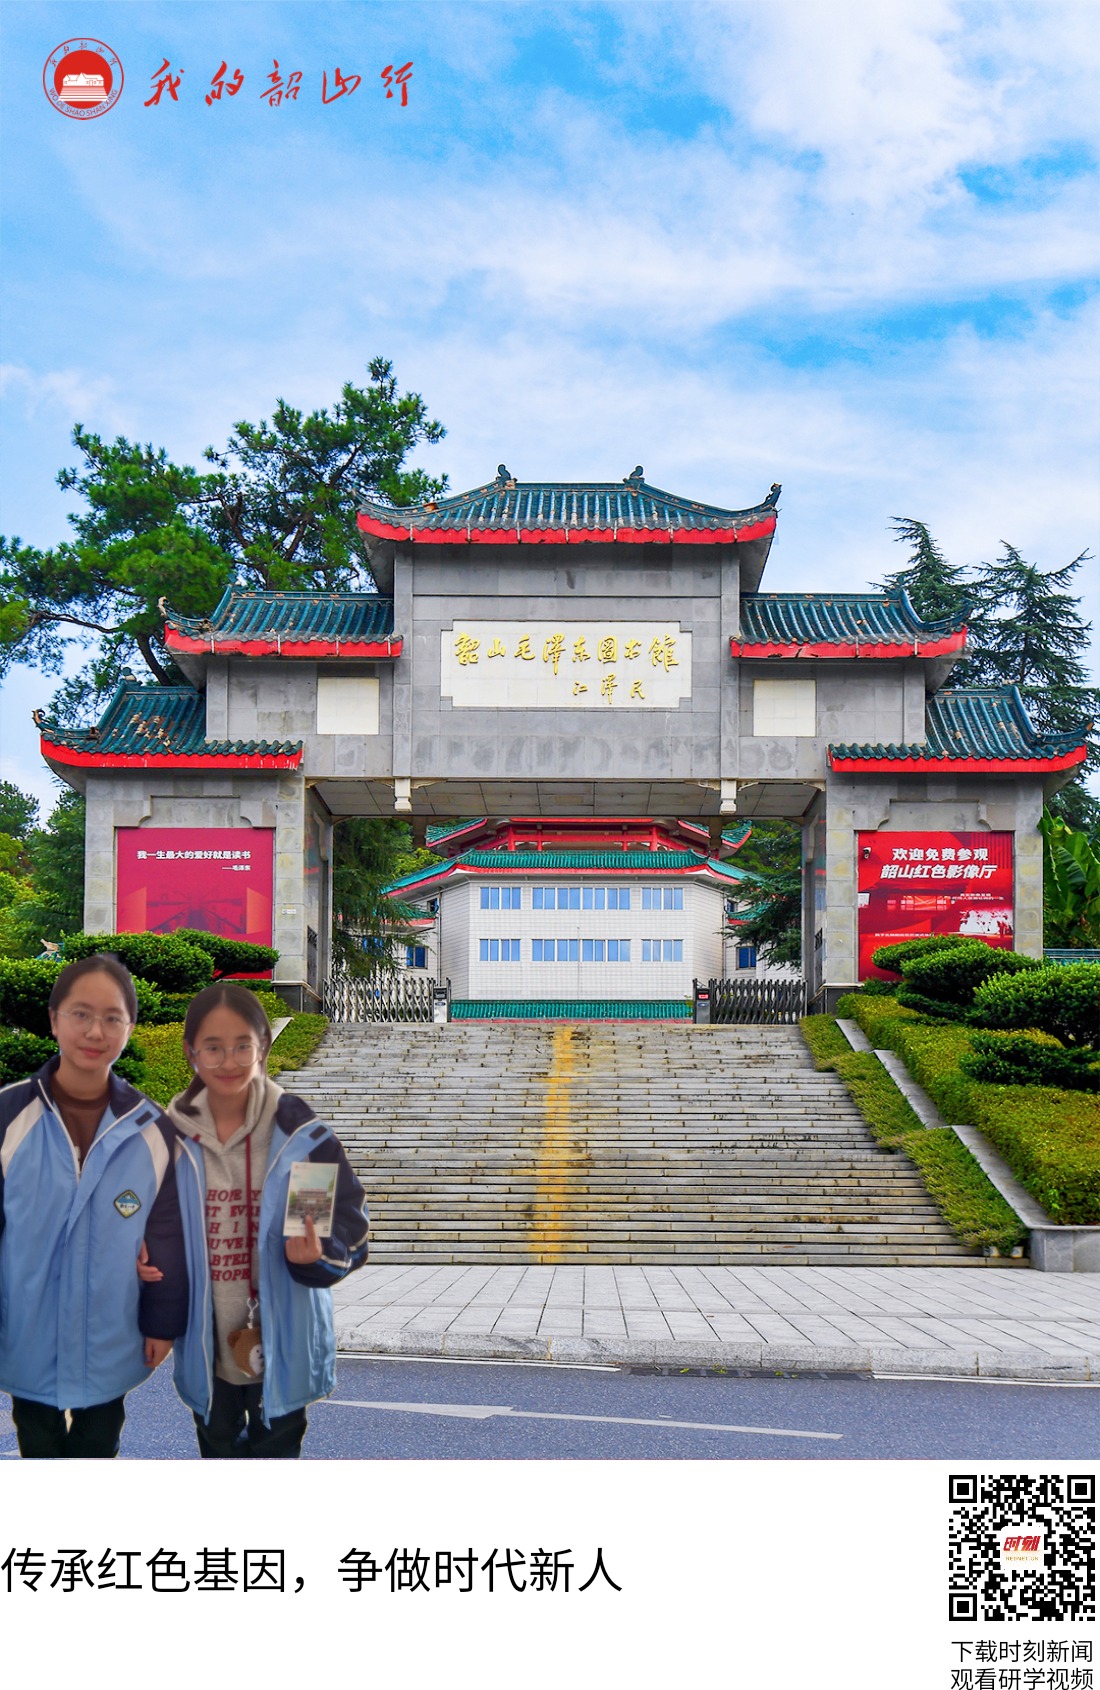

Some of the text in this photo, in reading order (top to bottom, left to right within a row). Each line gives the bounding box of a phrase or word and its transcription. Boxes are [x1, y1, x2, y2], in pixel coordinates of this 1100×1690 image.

[137, 850, 251, 860] 我一生最大的爱好就是读书
[892, 848, 989, 861] 欢迎免费参观
[880, 864, 998, 879] 韶山红色影像厅
